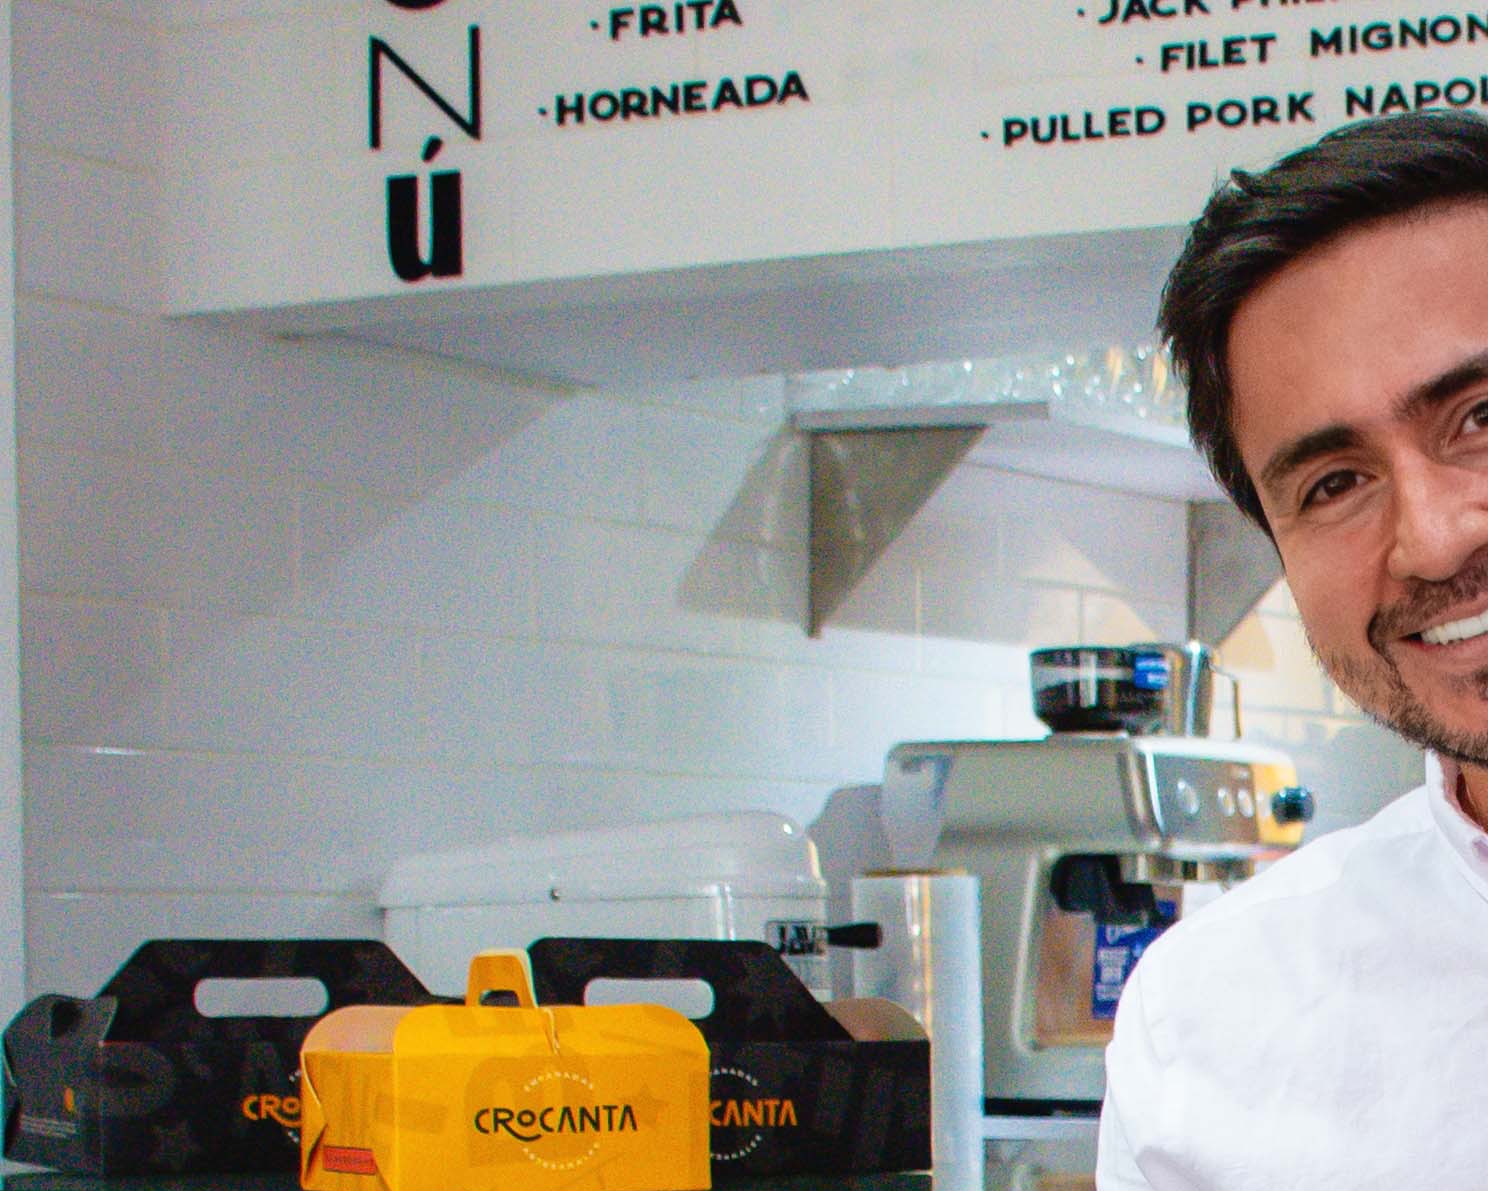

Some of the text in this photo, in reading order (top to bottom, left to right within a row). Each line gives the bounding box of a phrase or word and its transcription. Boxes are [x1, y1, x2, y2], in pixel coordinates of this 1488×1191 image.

[609, 0, 742, 41] FRITA
[1160, 32, 1277, 72] FILET
[556, 71, 811, 126] HORNEADA
[1002, 107, 1166, 147] PULLED
[1187, 92, 1315, 133] PORK
[474, 1104, 638, 1142] CROCANTA
